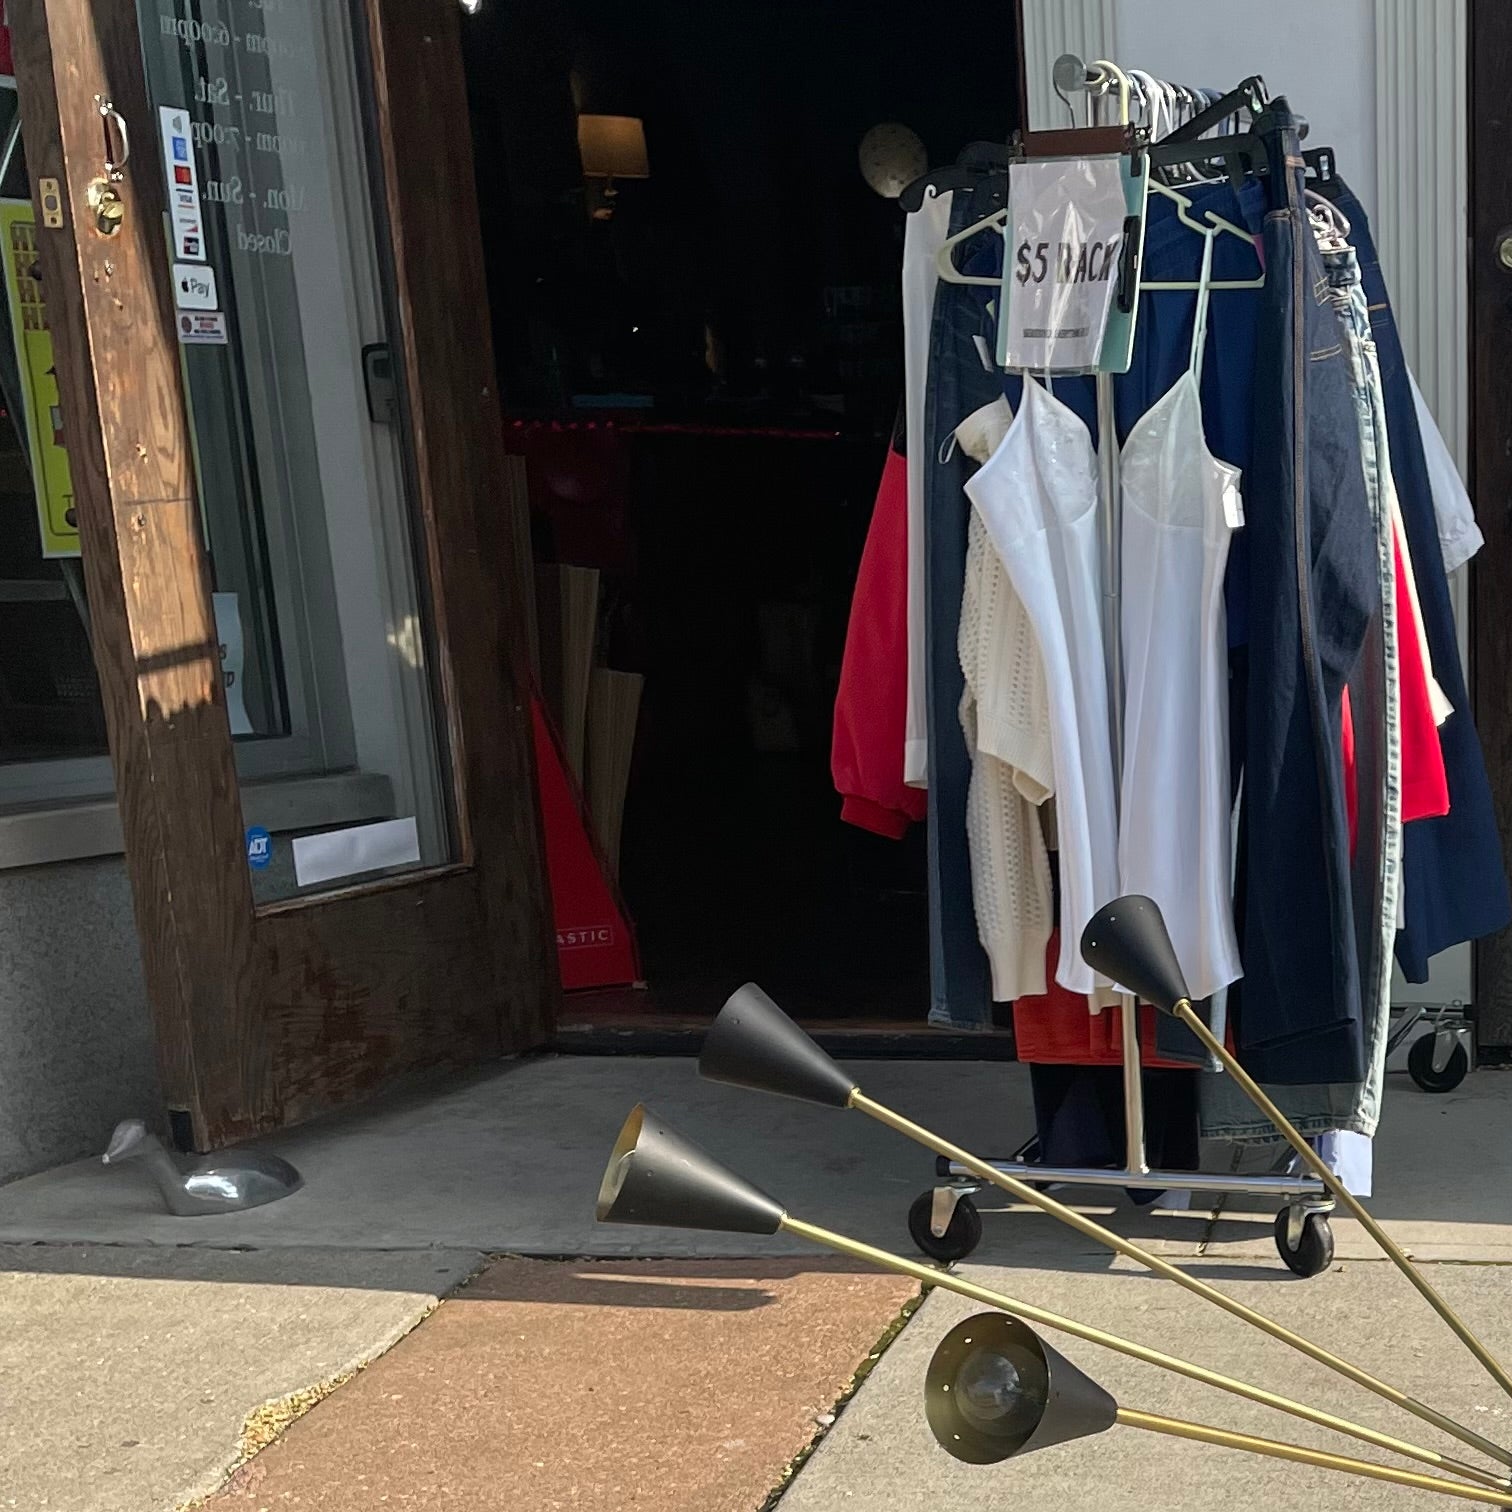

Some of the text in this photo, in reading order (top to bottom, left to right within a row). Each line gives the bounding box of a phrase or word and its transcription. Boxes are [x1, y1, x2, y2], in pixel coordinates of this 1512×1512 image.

[1016, 238, 1120, 287] $5 RACK
[190, 277, 210, 298] Pay
[248, 837, 268, 856] ADT
